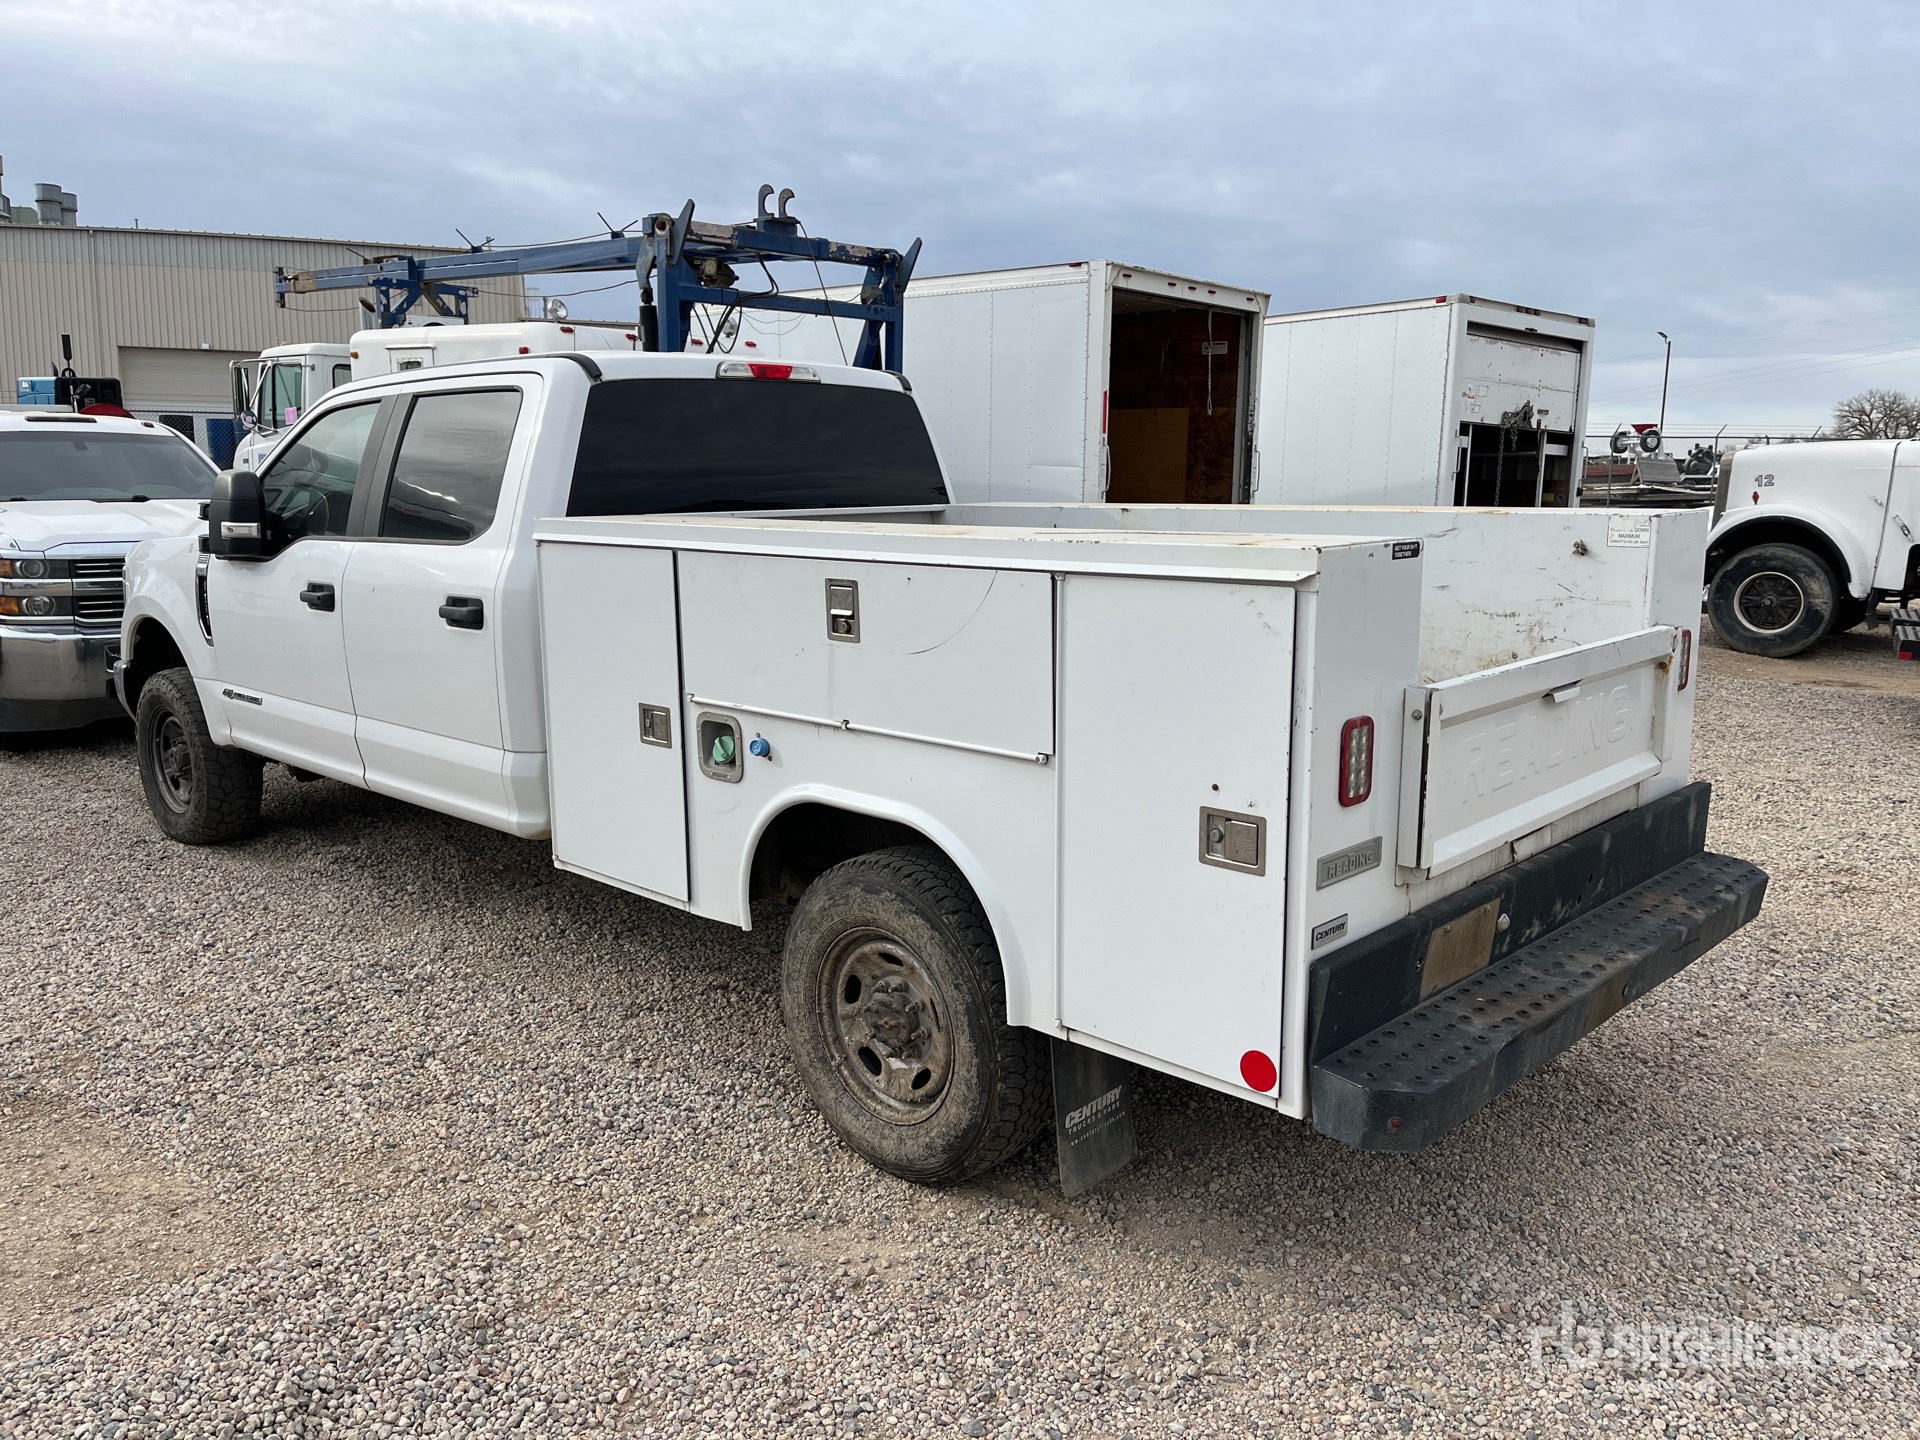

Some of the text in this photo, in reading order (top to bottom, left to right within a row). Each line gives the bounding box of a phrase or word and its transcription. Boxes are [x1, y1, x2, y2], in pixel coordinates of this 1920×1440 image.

[1754, 473, 1775, 488] 12
[1460, 684, 1631, 805] READING
[1327, 850, 1373, 881] READING
[1315, 921, 1347, 942] CENTURY
[1065, 1085, 1122, 1129] CENTURY
[1068, 1115, 1096, 1135] TRUCKS
[1103, 1100, 1120, 1115] VANS
